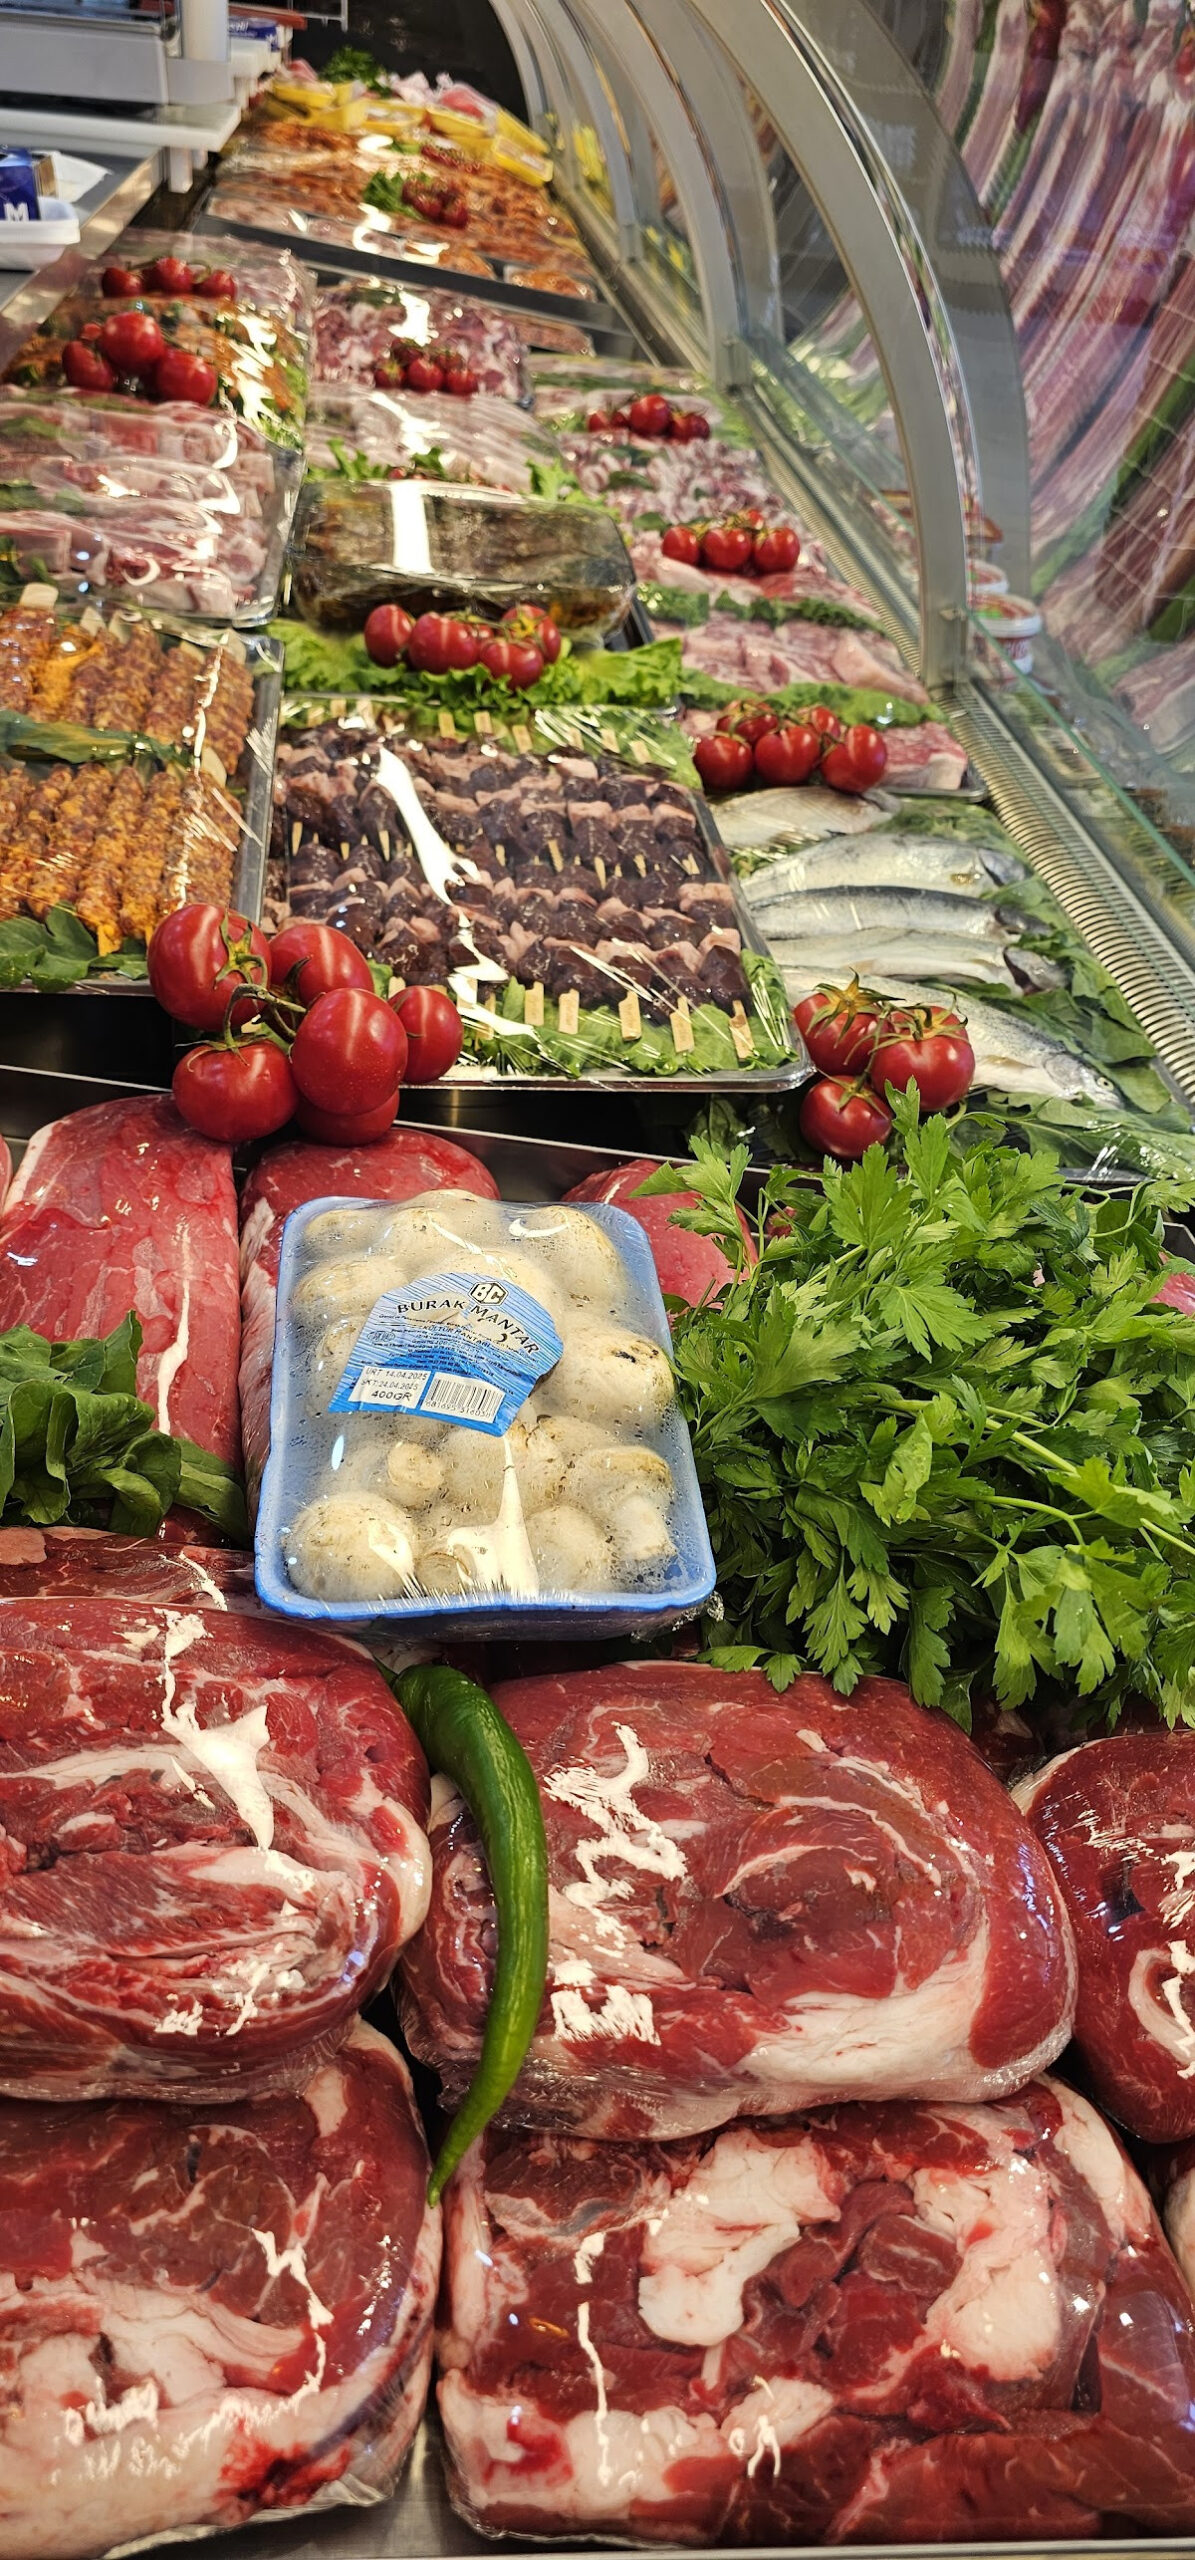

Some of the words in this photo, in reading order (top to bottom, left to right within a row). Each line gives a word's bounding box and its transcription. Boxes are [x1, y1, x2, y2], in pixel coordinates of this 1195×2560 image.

[470, 1282, 508, 1305] BC
[397, 1299, 466, 1314] BURAK
[470, 1305, 540, 1354] MANTAR
[371, 1390, 413, 1402] 400GR
